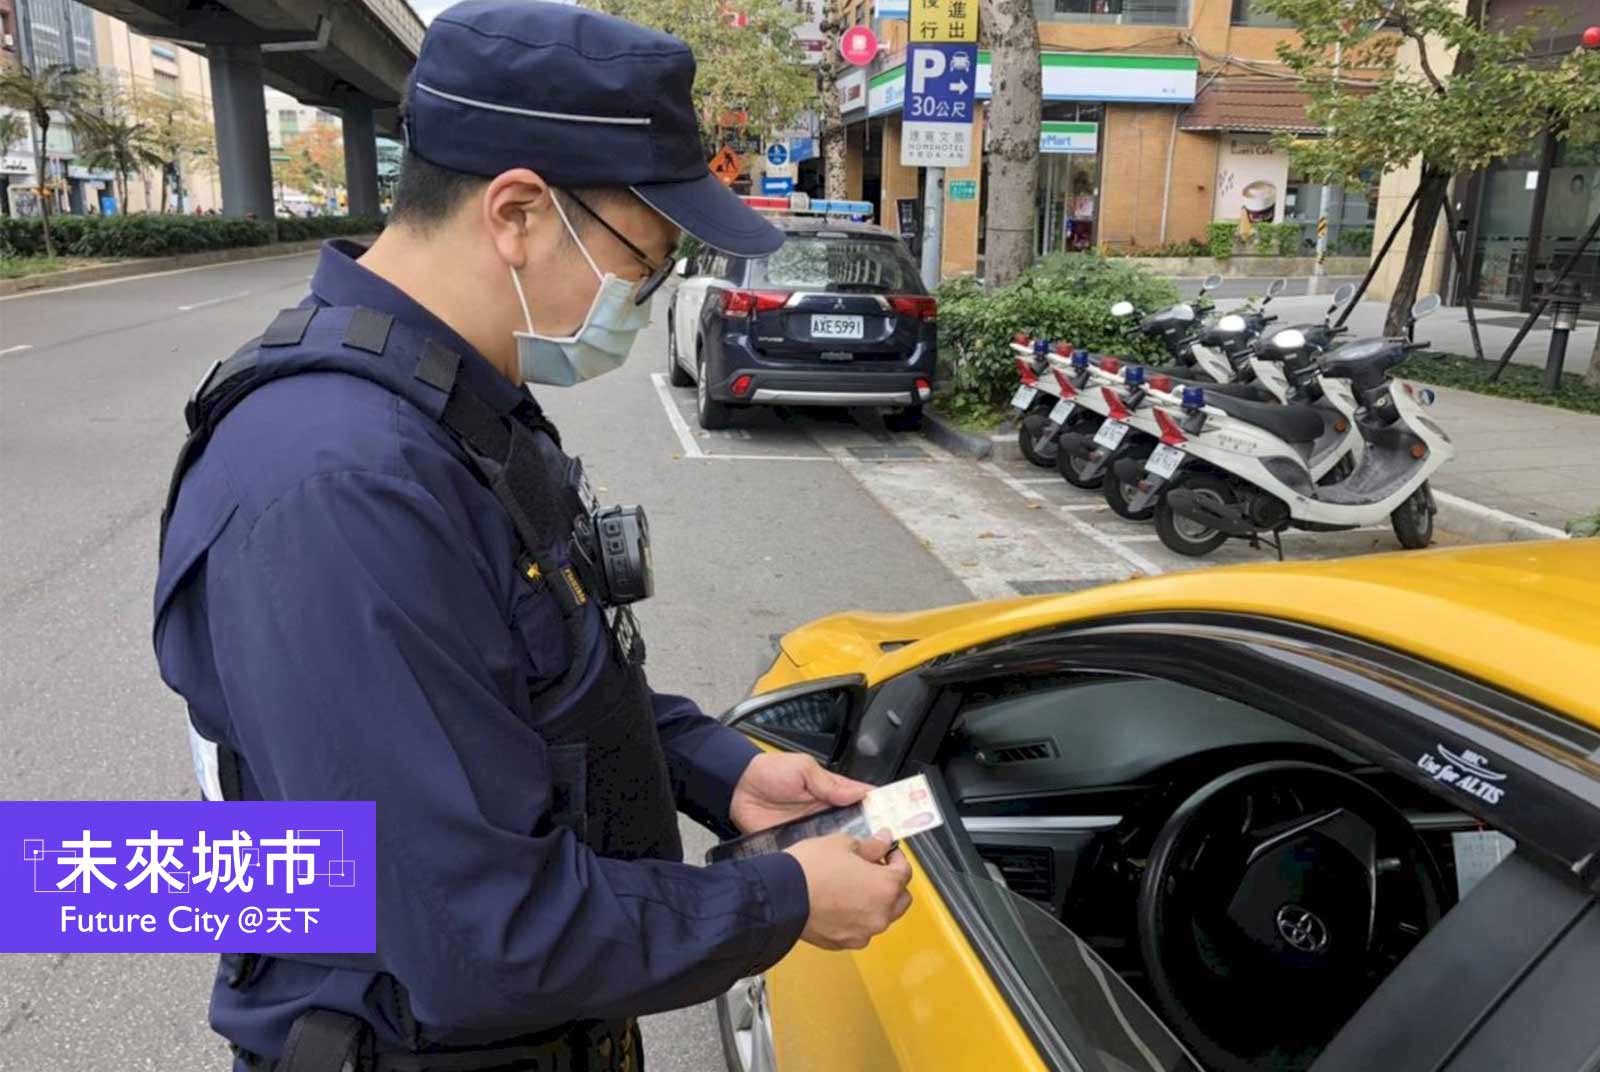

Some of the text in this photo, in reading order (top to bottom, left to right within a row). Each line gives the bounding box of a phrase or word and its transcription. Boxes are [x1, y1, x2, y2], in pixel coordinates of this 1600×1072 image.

[912, 49, 946, 93] P
[911, 96, 966, 118] 30公尺
[1417, 753, 1441, 774] Use
[1455, 775, 1505, 804] ALTIS
